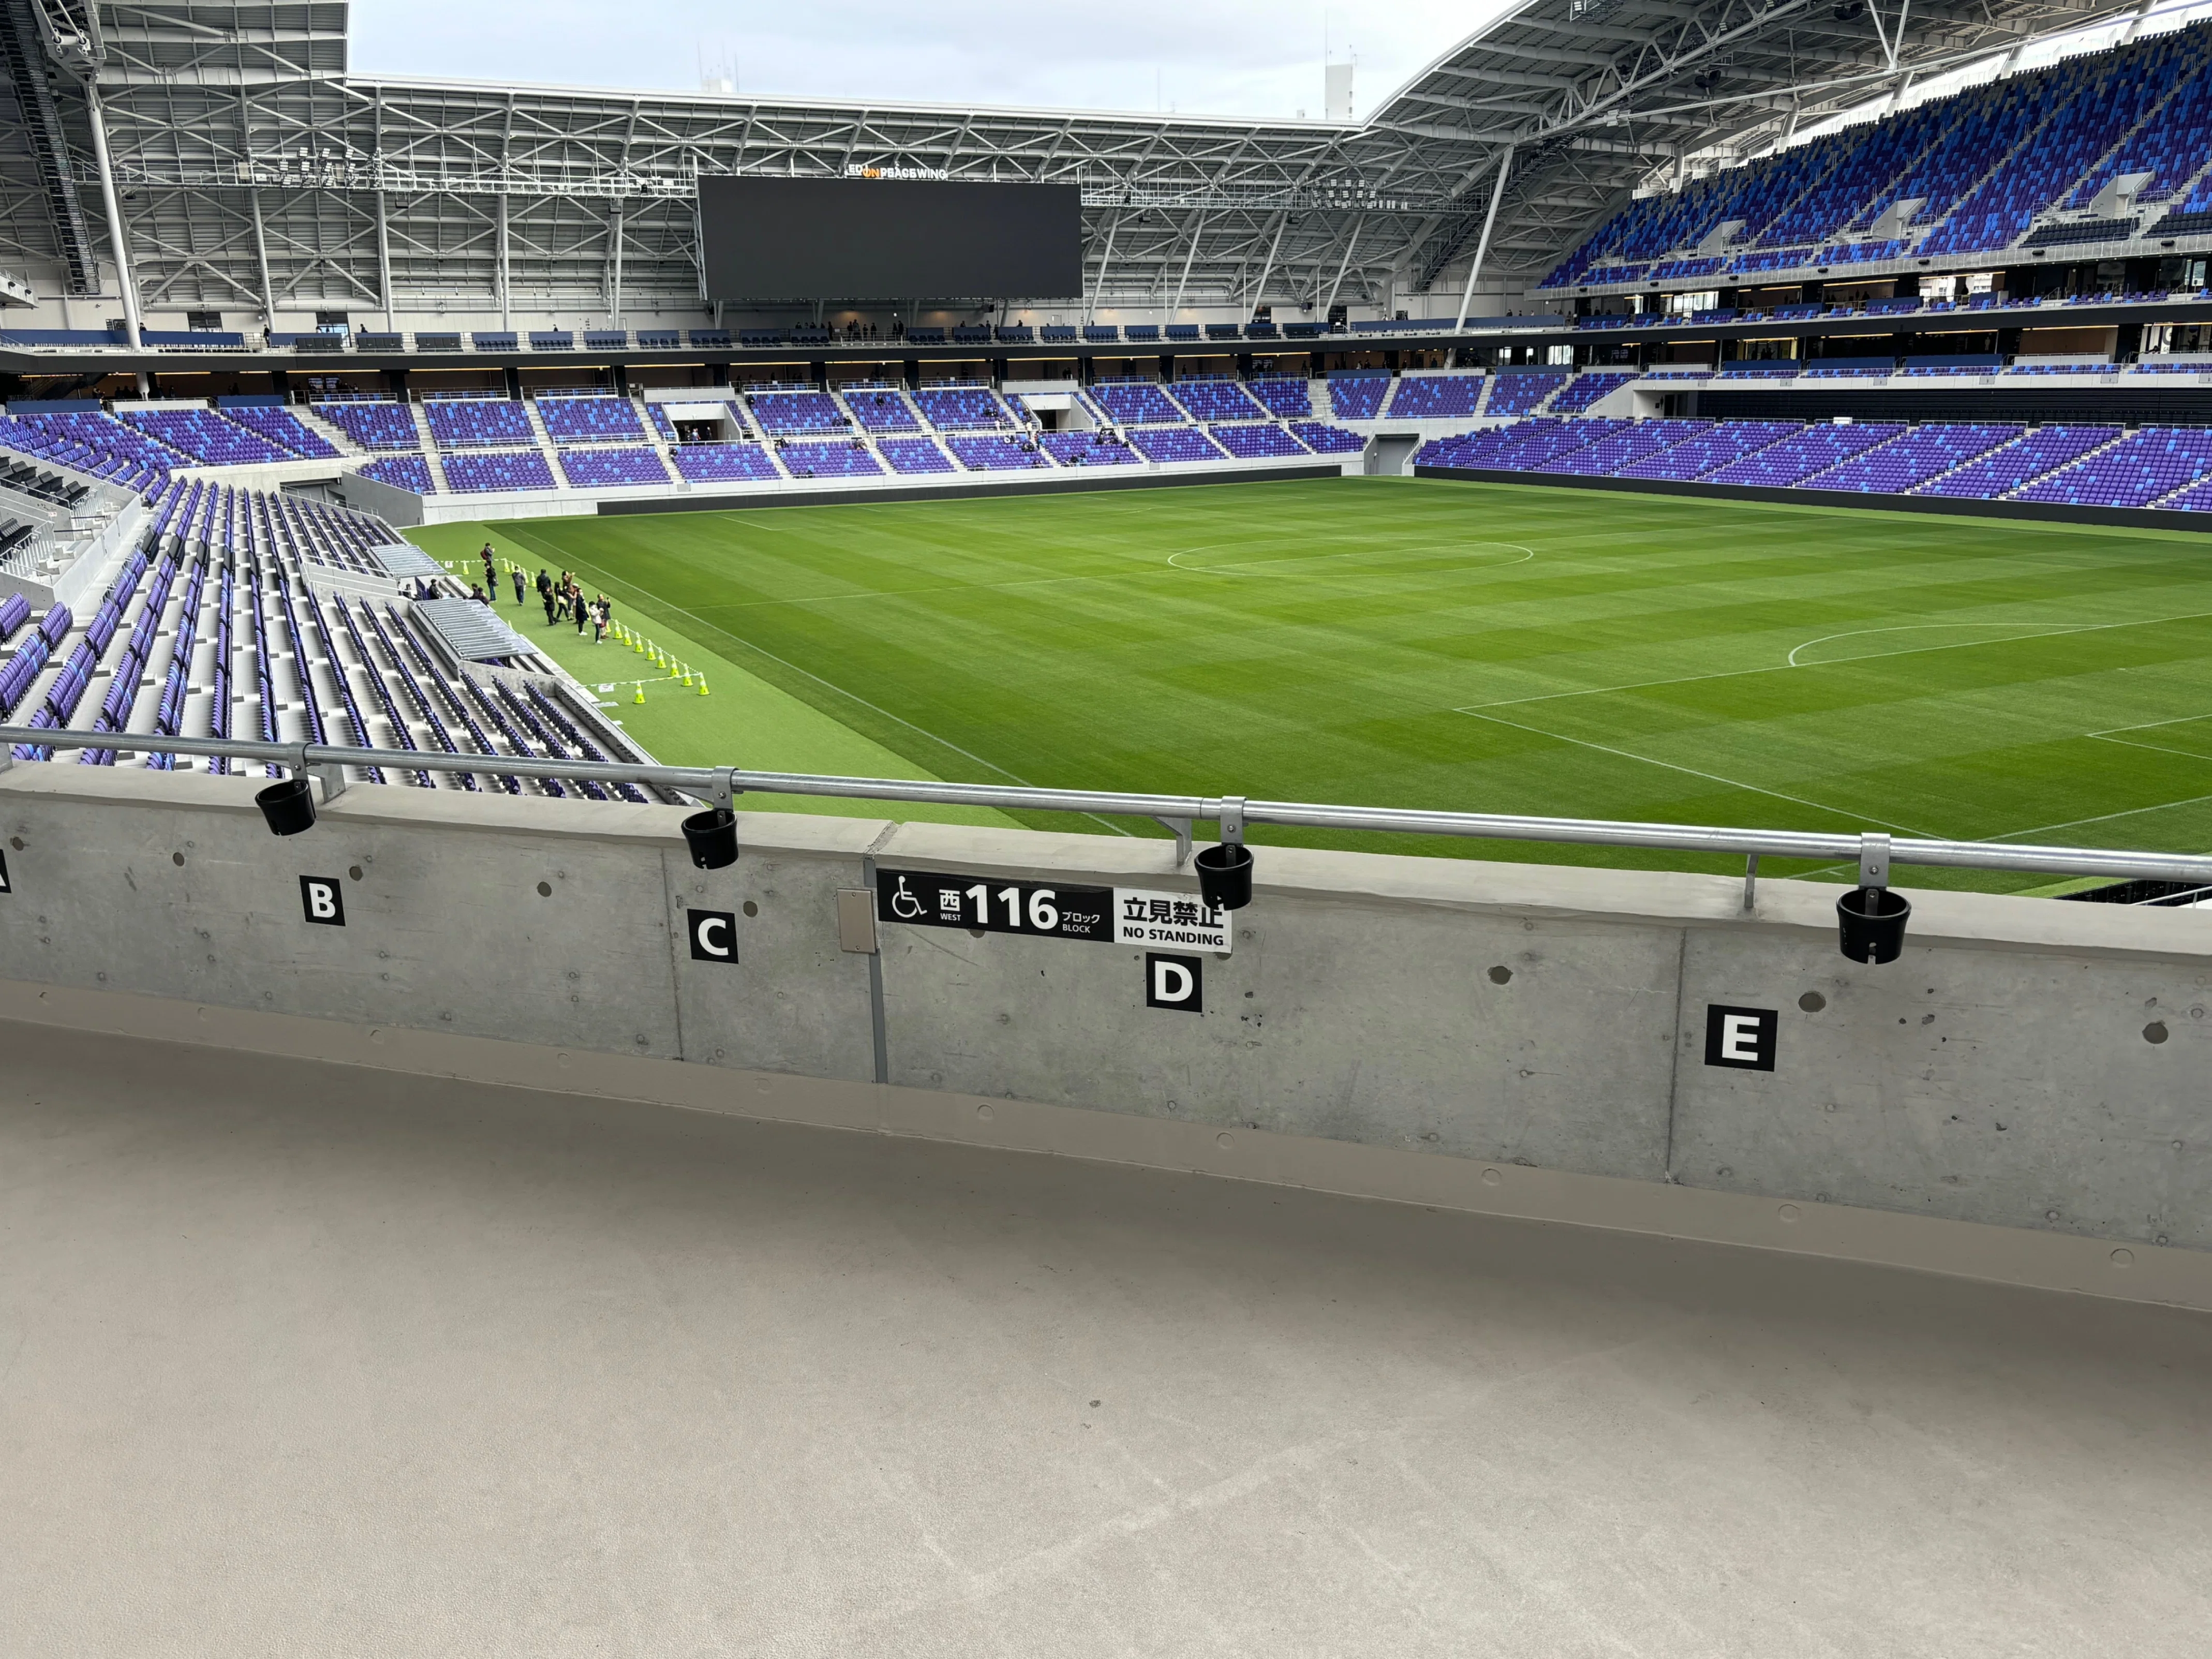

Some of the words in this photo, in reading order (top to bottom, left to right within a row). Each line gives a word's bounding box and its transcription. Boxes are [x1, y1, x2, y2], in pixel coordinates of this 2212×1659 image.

[309, 883, 335, 918] B
[939, 890, 960, 911] 西
[966, 884, 1058, 929] 116
[1062, 912, 1100, 924] ブロック
[940, 913, 961, 921] WEST
[1123, 897, 1224, 929] 立見禁止
[698, 918, 729, 956] C
[1062, 924, 1090, 934] BLOCK
[1123, 926, 1145, 939] NO
[1149, 929, 1224, 946] STANDING
[1155, 960, 1193, 1001] D
[1722, 1014, 1760, 1061] E
